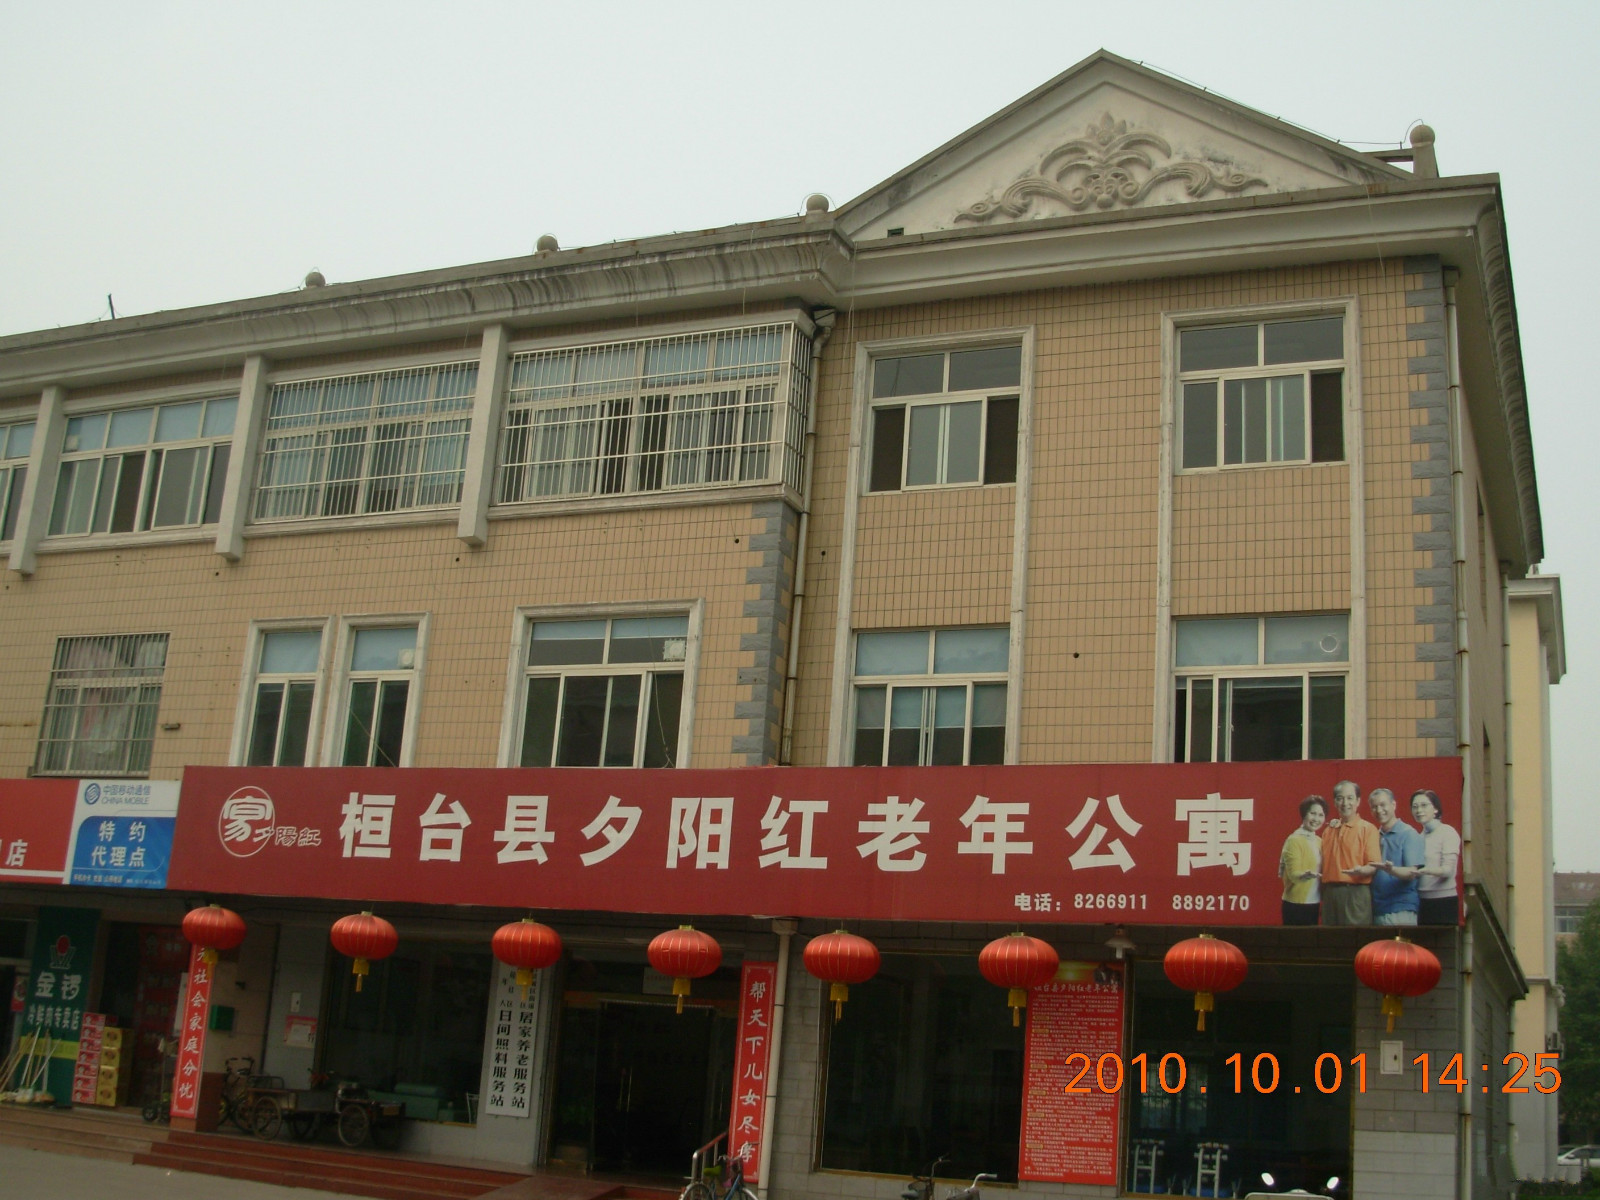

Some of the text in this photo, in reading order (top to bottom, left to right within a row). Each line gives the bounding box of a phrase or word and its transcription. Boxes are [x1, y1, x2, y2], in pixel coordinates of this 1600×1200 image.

[101, 796, 150, 806] CHINA MOBILE
[103, 784, 152, 796] 中国移动通信
[339, 792, 1254, 876] 桓台县夕阳红老年公寓
[0, 839, 28, 867] 店
[91, 846, 146, 868] 代理点
[1074, 893, 1148, 910] 8266911
[1172, 895, 1250, 911] 8892170
[35, 971, 82, 1000] 金锣
[490, 1010, 512, 1107] 日间照料服务站
[511, 1012, 534, 1109] 居家养老服务站
